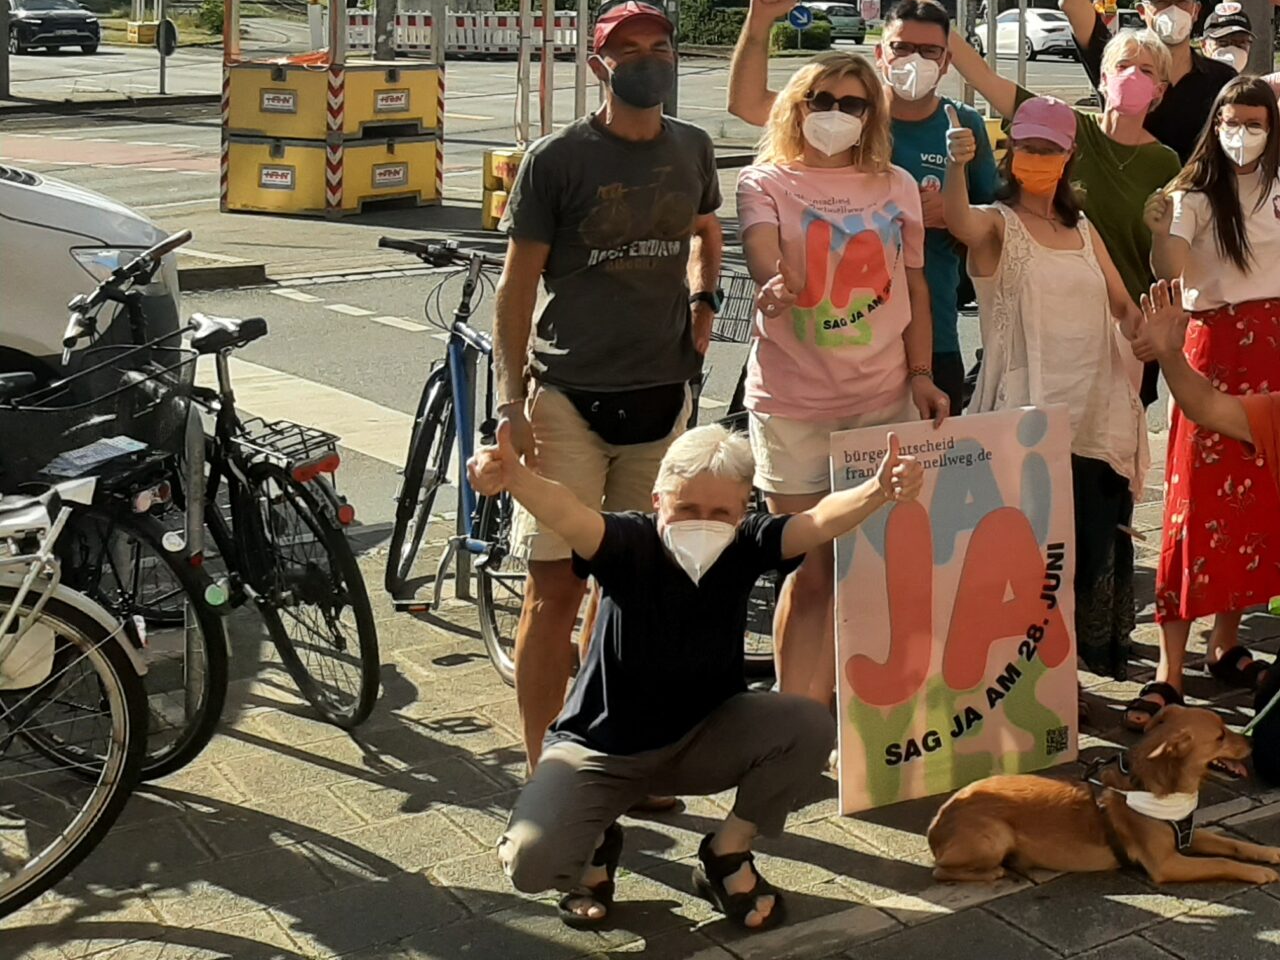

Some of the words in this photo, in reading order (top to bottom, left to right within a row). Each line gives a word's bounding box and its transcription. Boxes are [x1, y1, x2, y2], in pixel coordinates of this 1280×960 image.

[844, 436, 955, 464] bürgerntscheid
[845, 500, 1070, 707] JA
[885, 730, 942, 766] SAG
[950, 706, 983, 739] JA
[985, 662, 1021, 709] AM
[1040, 542, 1065, 609] JUNI
